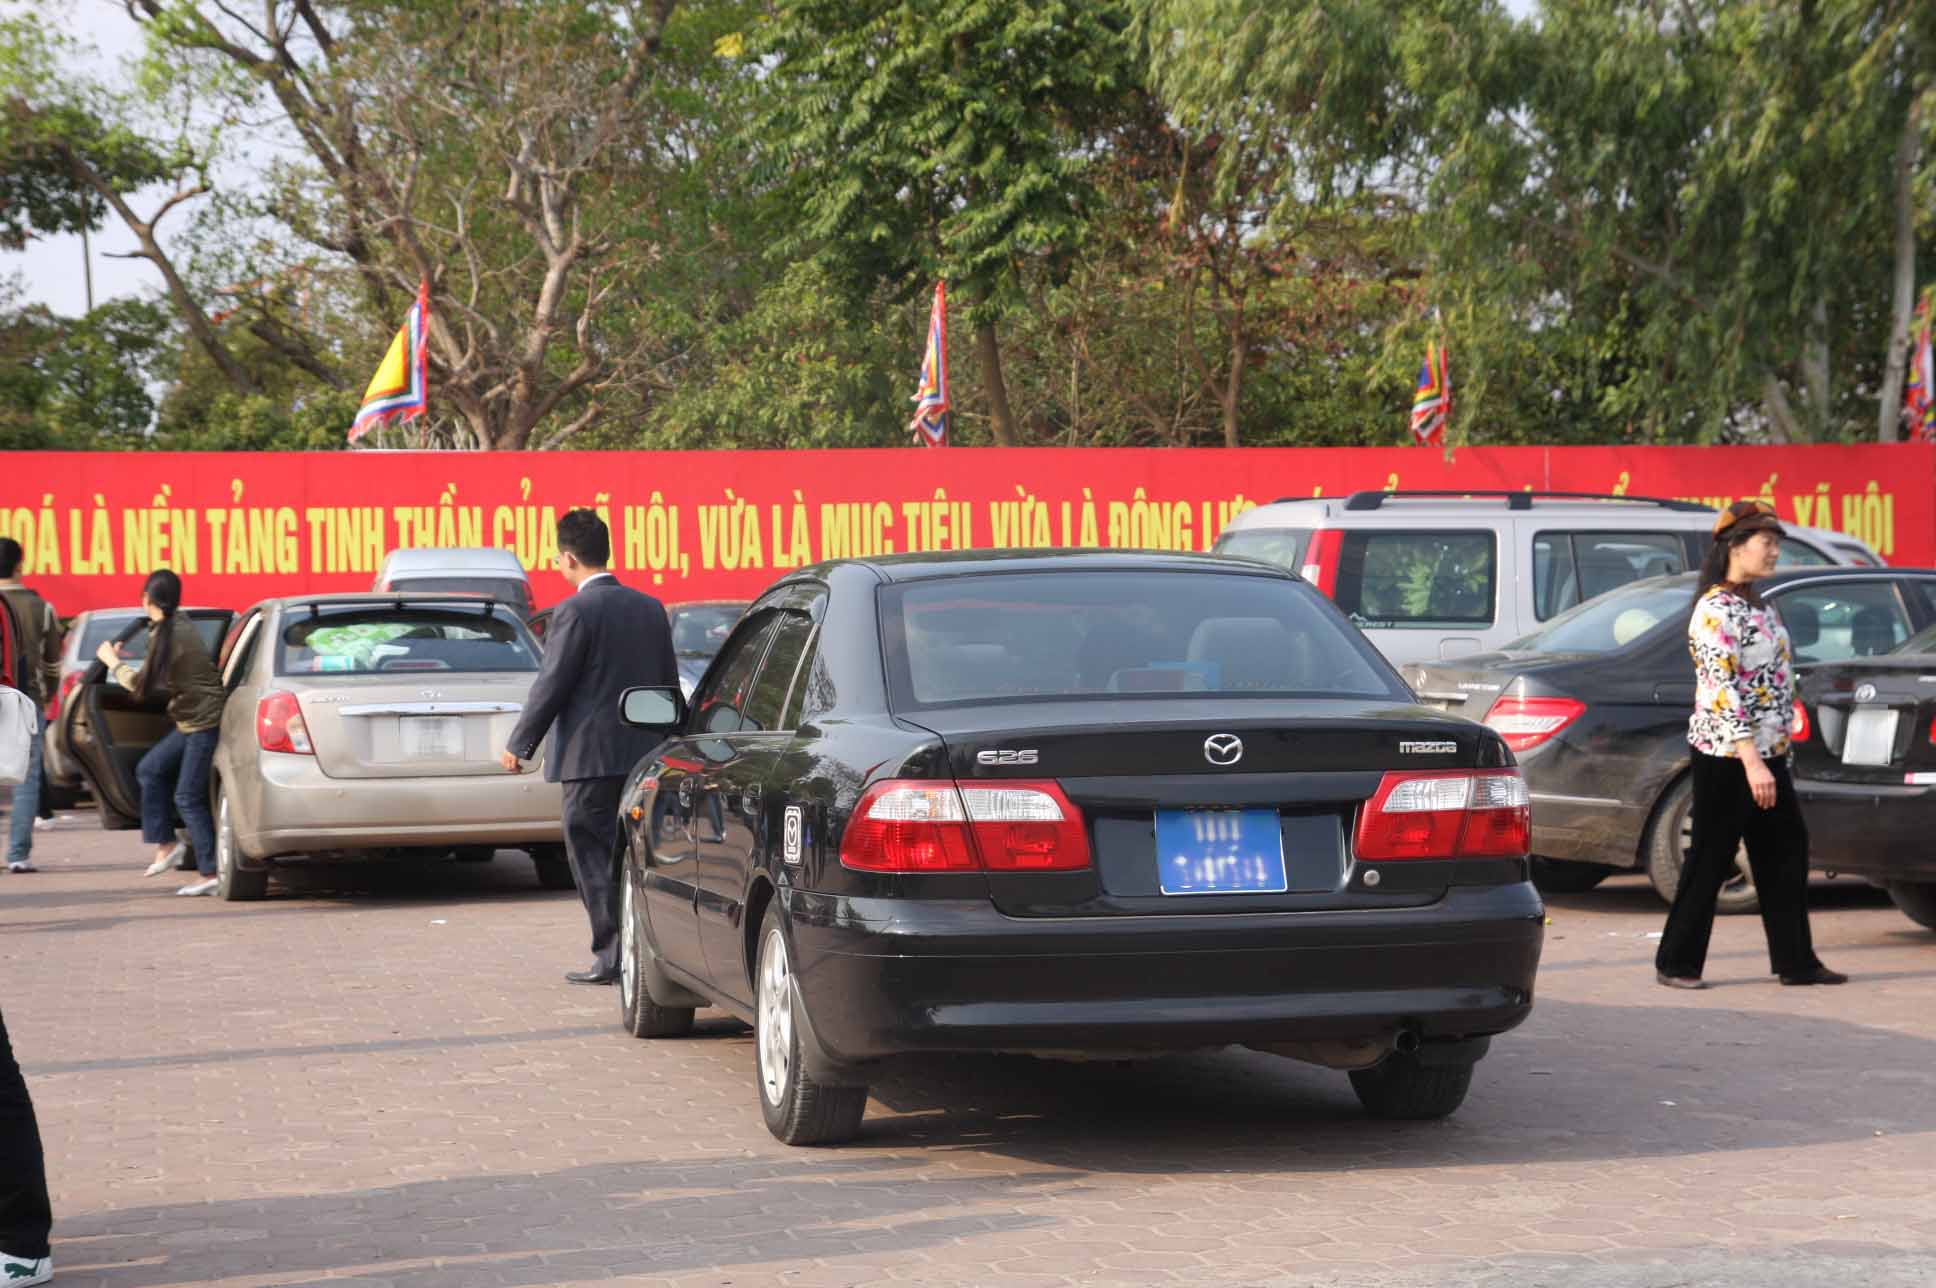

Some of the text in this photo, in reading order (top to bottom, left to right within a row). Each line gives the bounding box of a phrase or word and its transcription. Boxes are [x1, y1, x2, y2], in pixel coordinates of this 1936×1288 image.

[0, 493, 62, 575] OÁ
[70, 493, 115, 575] LÀ
[124, 484, 196, 574] NỀN
[206, 479, 298, 574] TẢNG
[306, 507, 384, 572] TINH
[394, 483, 483, 550] THẦN
[494, 478, 561, 570] CỦA
[624, 491, 689, 584] HỘI,
[698, 488, 763, 569] VỪA
[772, 489, 812, 568] LÀ
[902, 487, 972, 553] TIÊU
[990, 485, 1051, 549] VỪA
